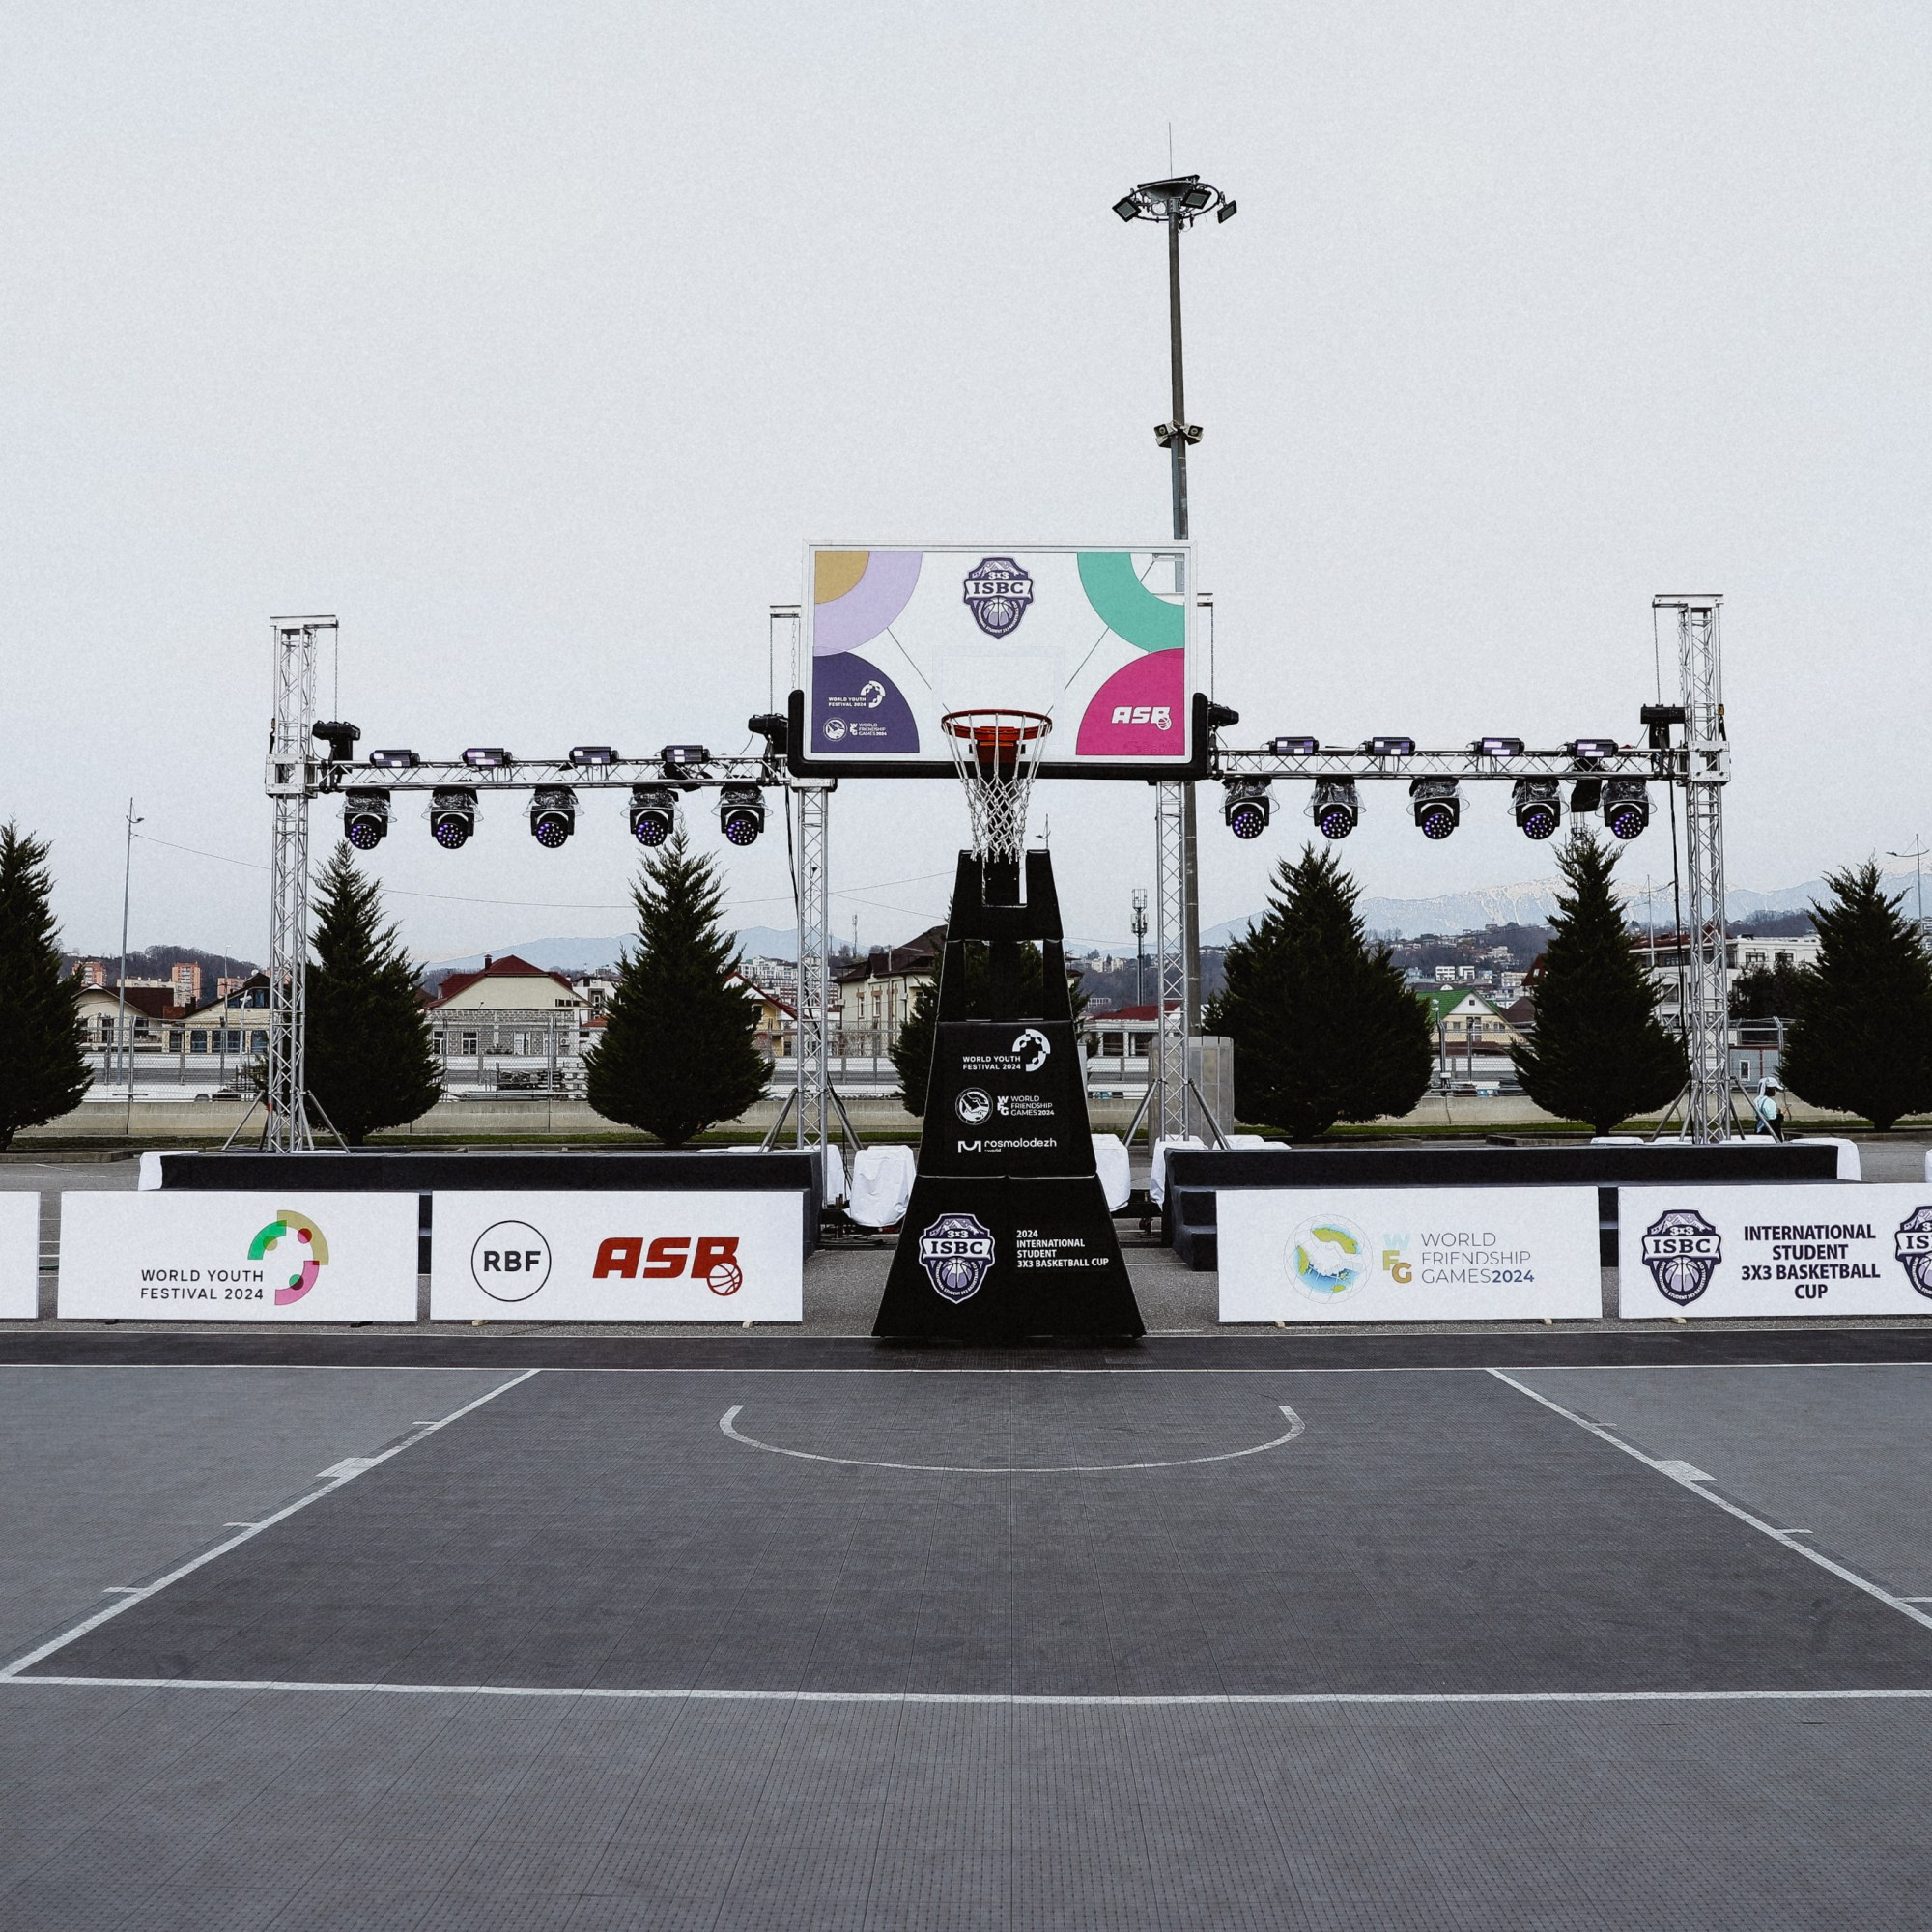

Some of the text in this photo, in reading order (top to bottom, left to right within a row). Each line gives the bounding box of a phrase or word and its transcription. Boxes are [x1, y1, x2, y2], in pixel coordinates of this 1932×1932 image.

[974, 582, 1023, 594] ISBC
[984, 1138, 1057, 1147] rosmolodezh
[1016, 1230, 1037, 1238] 2024
[1745, 1224, 1876, 1241] INTERNATIONAL
[1016, 1238, 1085, 1248] INTERNATIONAL
[1421, 1232, 1496, 1247] WORLD
[1653, 1239, 1710, 1253] ISBC
[1906, 1236, 1932, 1249] IS
[931, 1241, 982, 1254] ISBC
[1016, 1249, 1057, 1258] STUDENT
[1773, 1243, 1849, 1261] STUDENT
[483, 1250, 541, 1272] RBF
[1017, 1258, 1109, 1267] 3X3 BASKETBALL CUP
[1422, 1250, 1531, 1265] FRIENDSHIP
[141, 1269, 264, 1282] WORLD YOUTH
[1741, 1263, 1881, 1281] 3X3 BASKETBALL
[140, 1288, 264, 1300] FESTIVAL 2024
[1795, 1284, 1829, 1299] CUP
